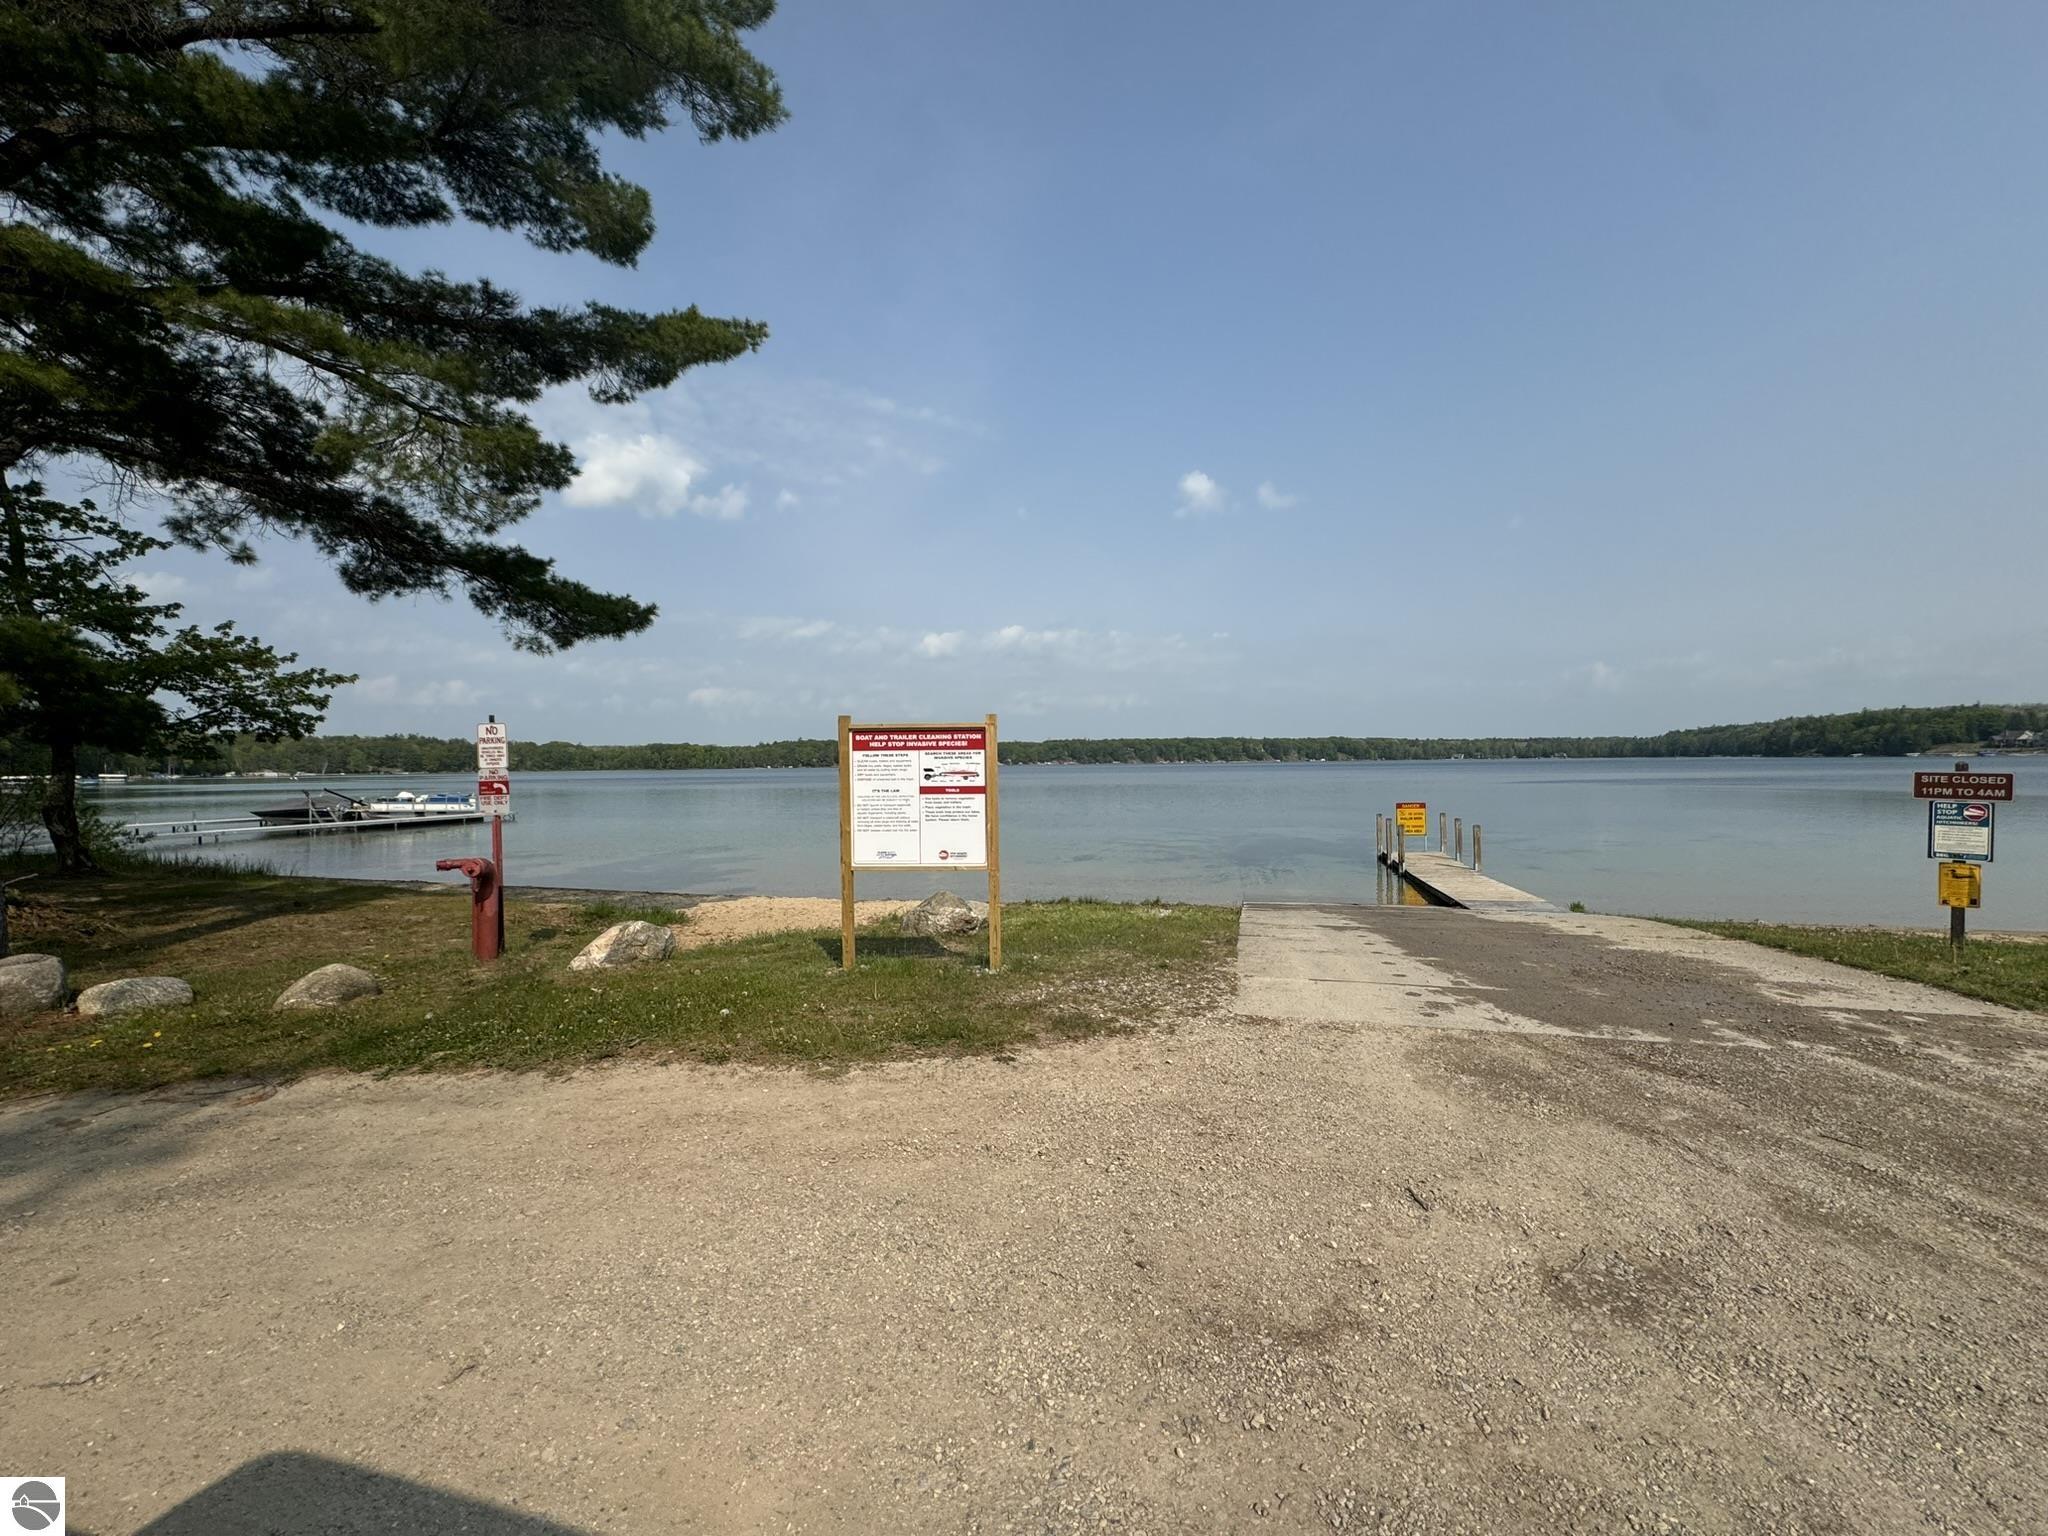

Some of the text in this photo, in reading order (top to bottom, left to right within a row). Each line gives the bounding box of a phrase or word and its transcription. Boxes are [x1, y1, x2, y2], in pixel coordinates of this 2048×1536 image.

[485, 726, 498, 735] NO
[1921, 775, 2007, 785] SITE CLOSED
[1921, 787, 2006, 797] 11PM TO 4AM
